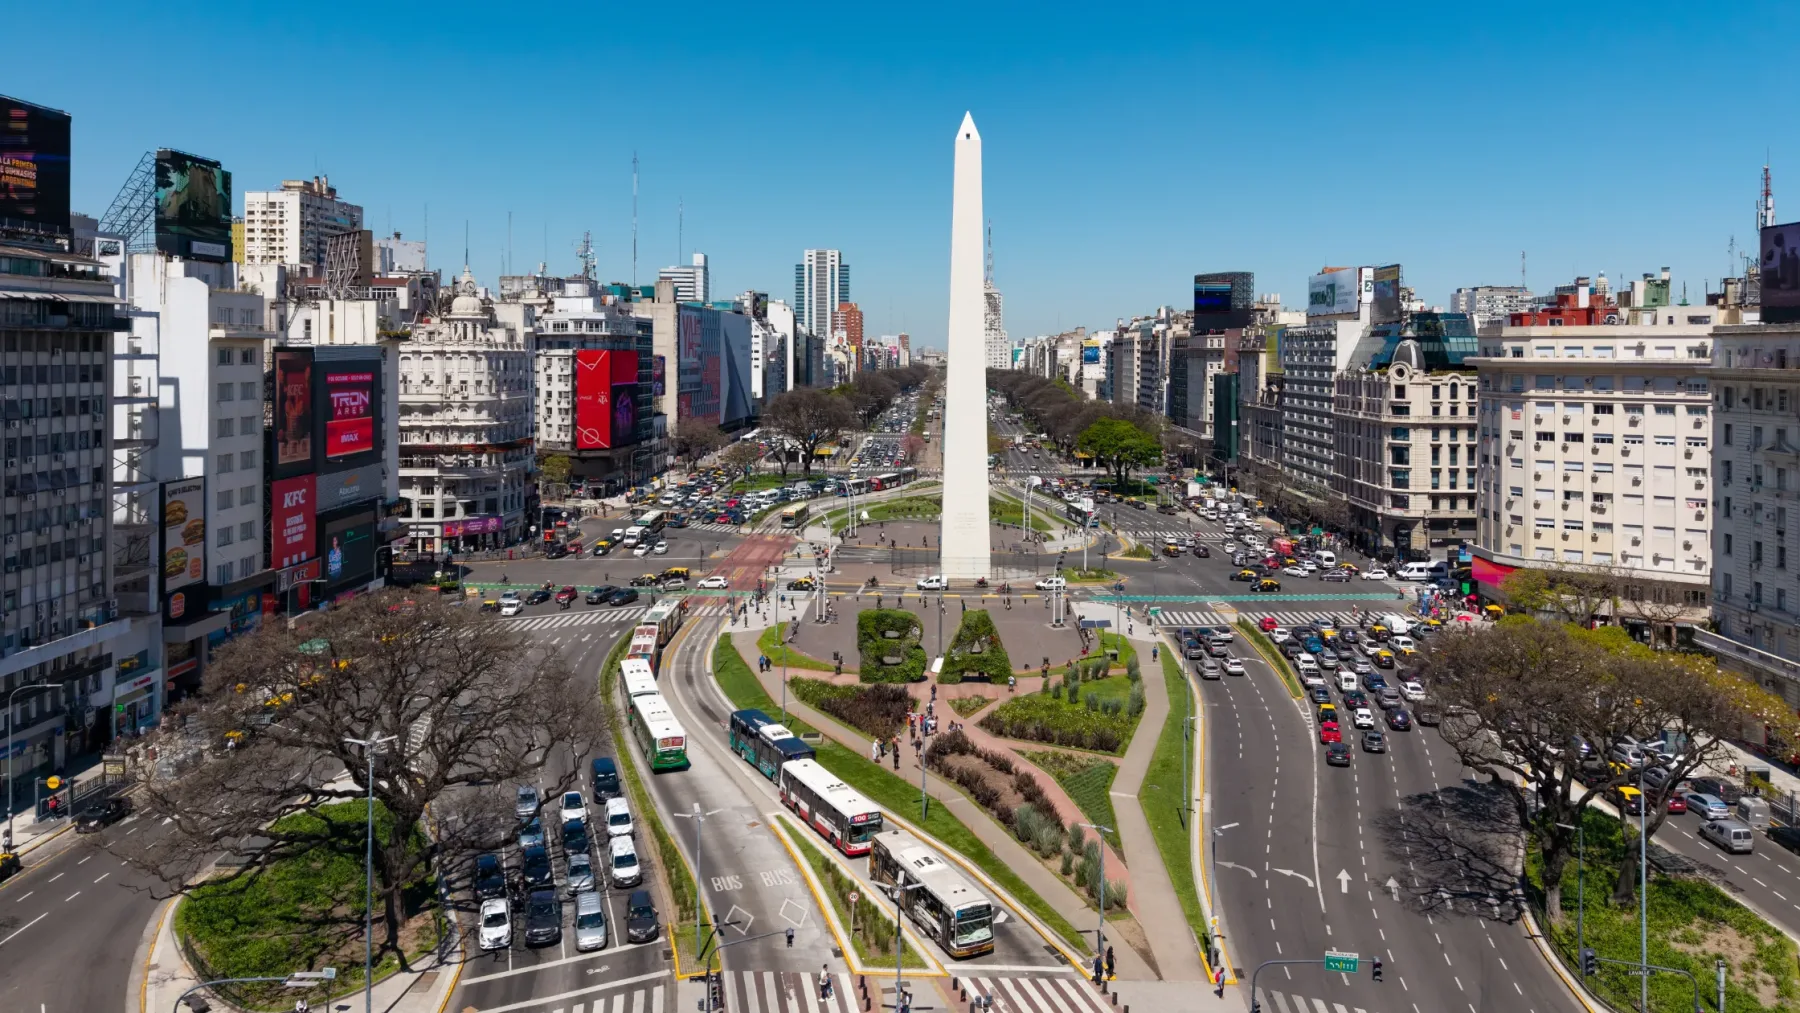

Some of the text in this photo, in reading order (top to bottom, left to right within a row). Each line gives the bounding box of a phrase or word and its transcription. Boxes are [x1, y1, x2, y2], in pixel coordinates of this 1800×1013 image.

[12, 159, 37, 171] PRIMERA
[5, 167, 37, 179] GIMNASIOS
[1365, 281, 1372, 290] 2
[287, 384, 303, 396] KFC
[331, 391, 369, 407] TRON
[337, 406, 364, 416] ARES
[283, 488, 307, 509] KFC
[293, 567, 309, 582] KFC
[853, 814, 866, 822] 100
[710, 869, 794, 892] BUS BUS
